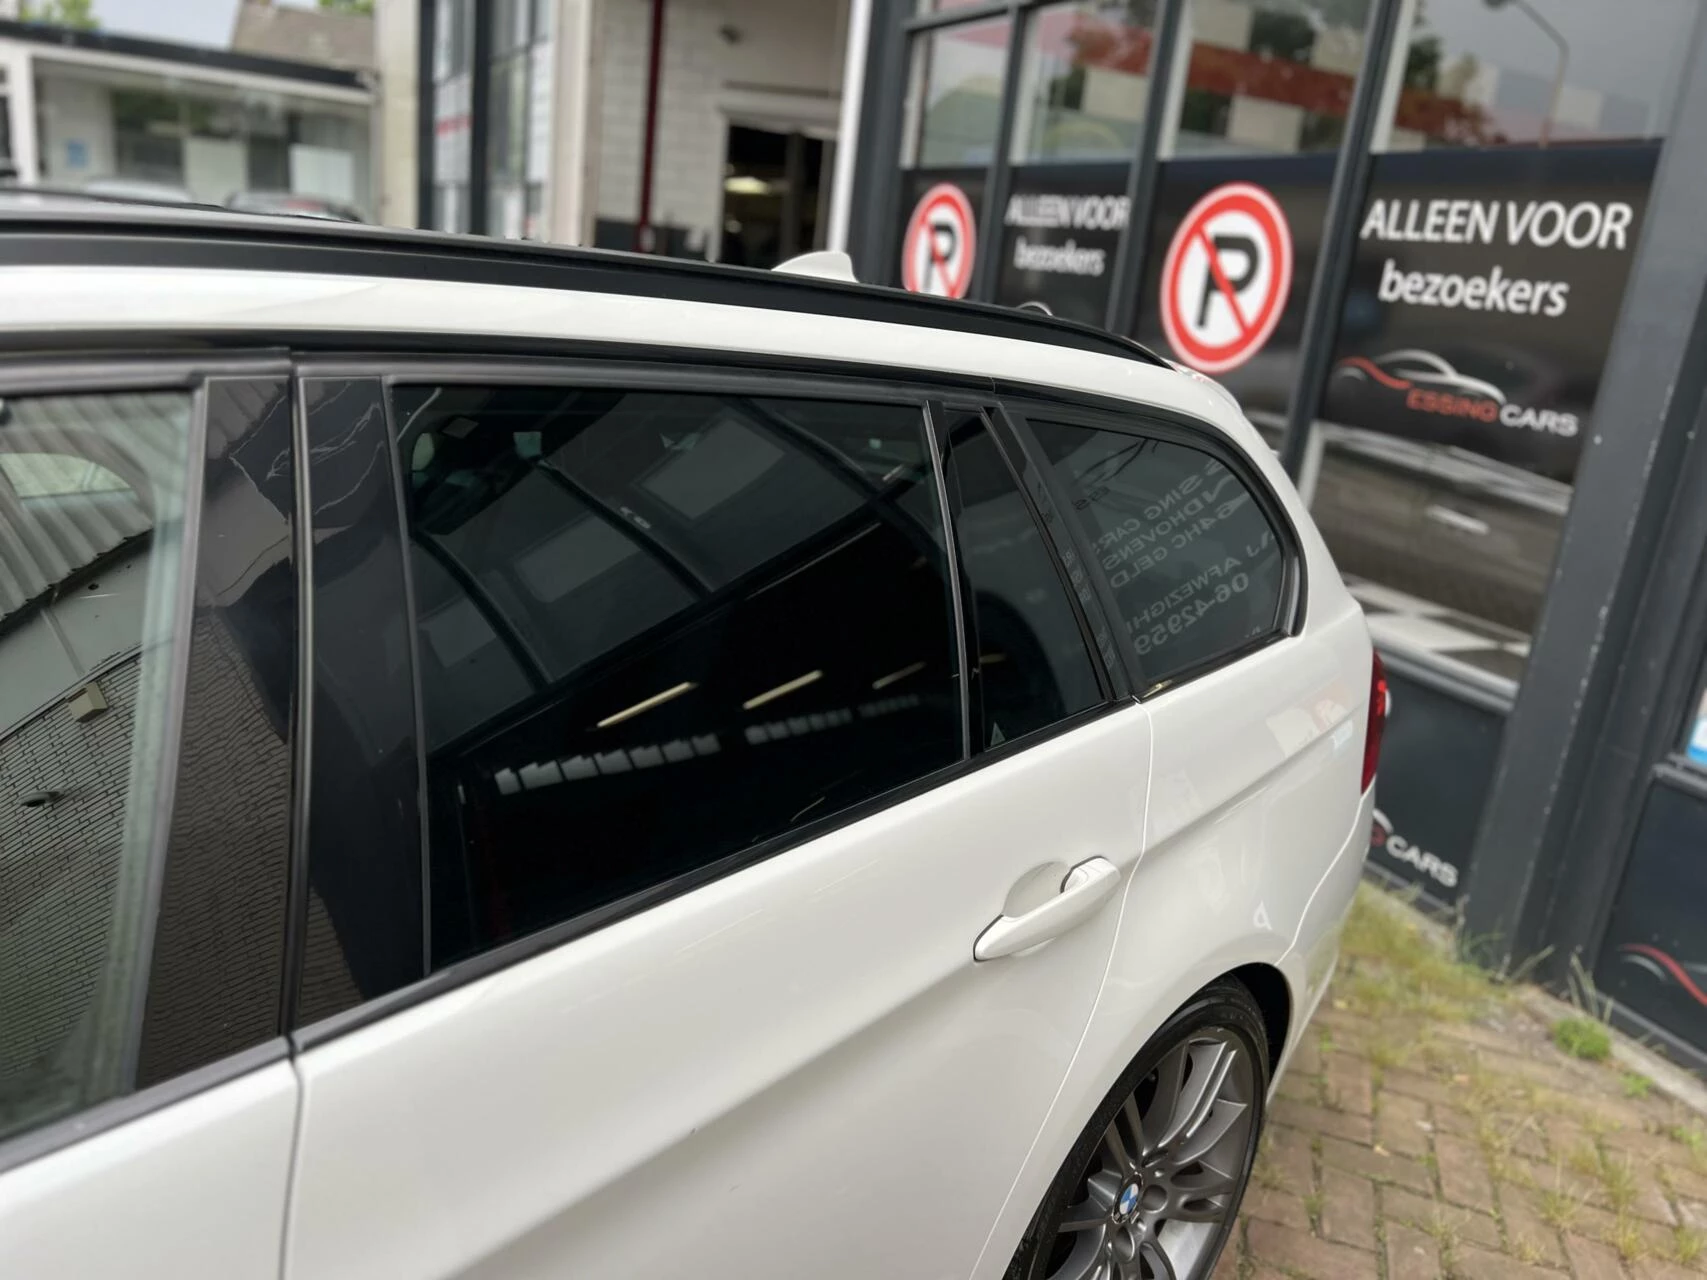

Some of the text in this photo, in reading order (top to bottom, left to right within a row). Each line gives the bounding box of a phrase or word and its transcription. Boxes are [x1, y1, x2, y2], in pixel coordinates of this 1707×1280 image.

[1005, 193, 1071, 228] ALLEEN
[1359, 199, 1633, 250] ALLEEN VOOR
[1013, 235, 1106, 276] bezoekers
[1377, 258, 1570, 316] bezoekers
[1406, 389, 1579, 437] ESSING CARS
[1386, 834, 1459, 888] CARS
